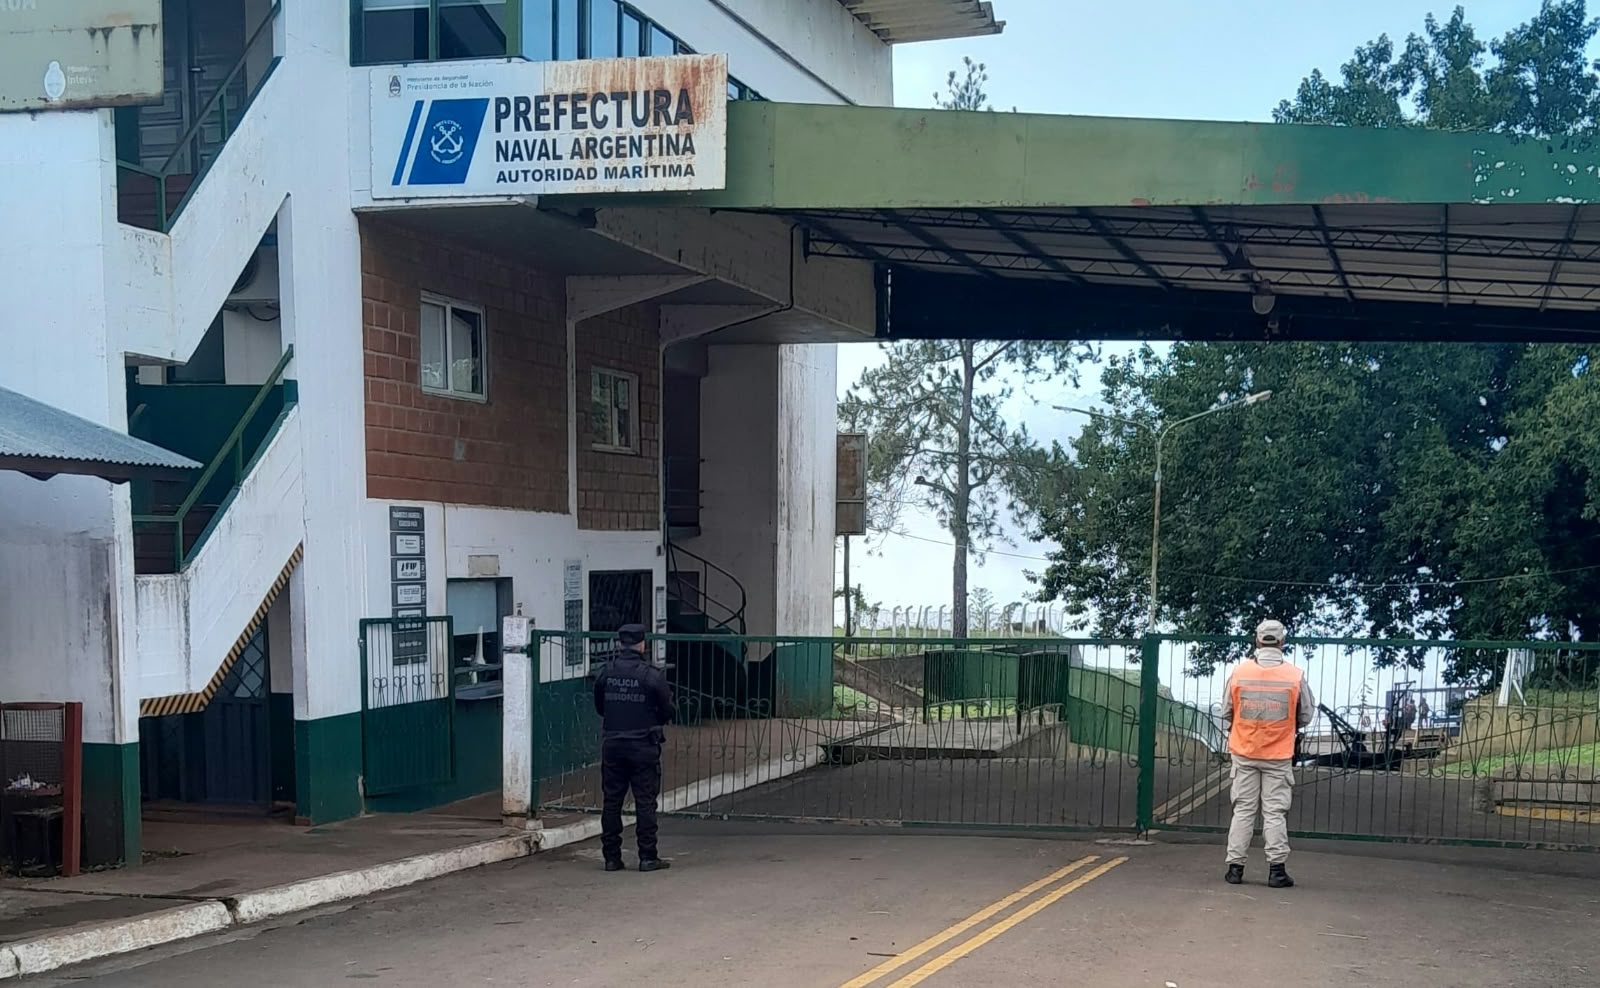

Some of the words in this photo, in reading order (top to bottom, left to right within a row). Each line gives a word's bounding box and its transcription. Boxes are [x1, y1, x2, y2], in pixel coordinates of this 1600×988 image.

[406, 83, 448, 91] Presidencia
[468, 80, 494, 88] Nación
[494, 88, 694, 133] PREFECTURA
[495, 138, 563, 162] NAVAL
[569, 133, 695, 159] ARGENTINA
[496, 166, 598, 184] AUTORIDAD
